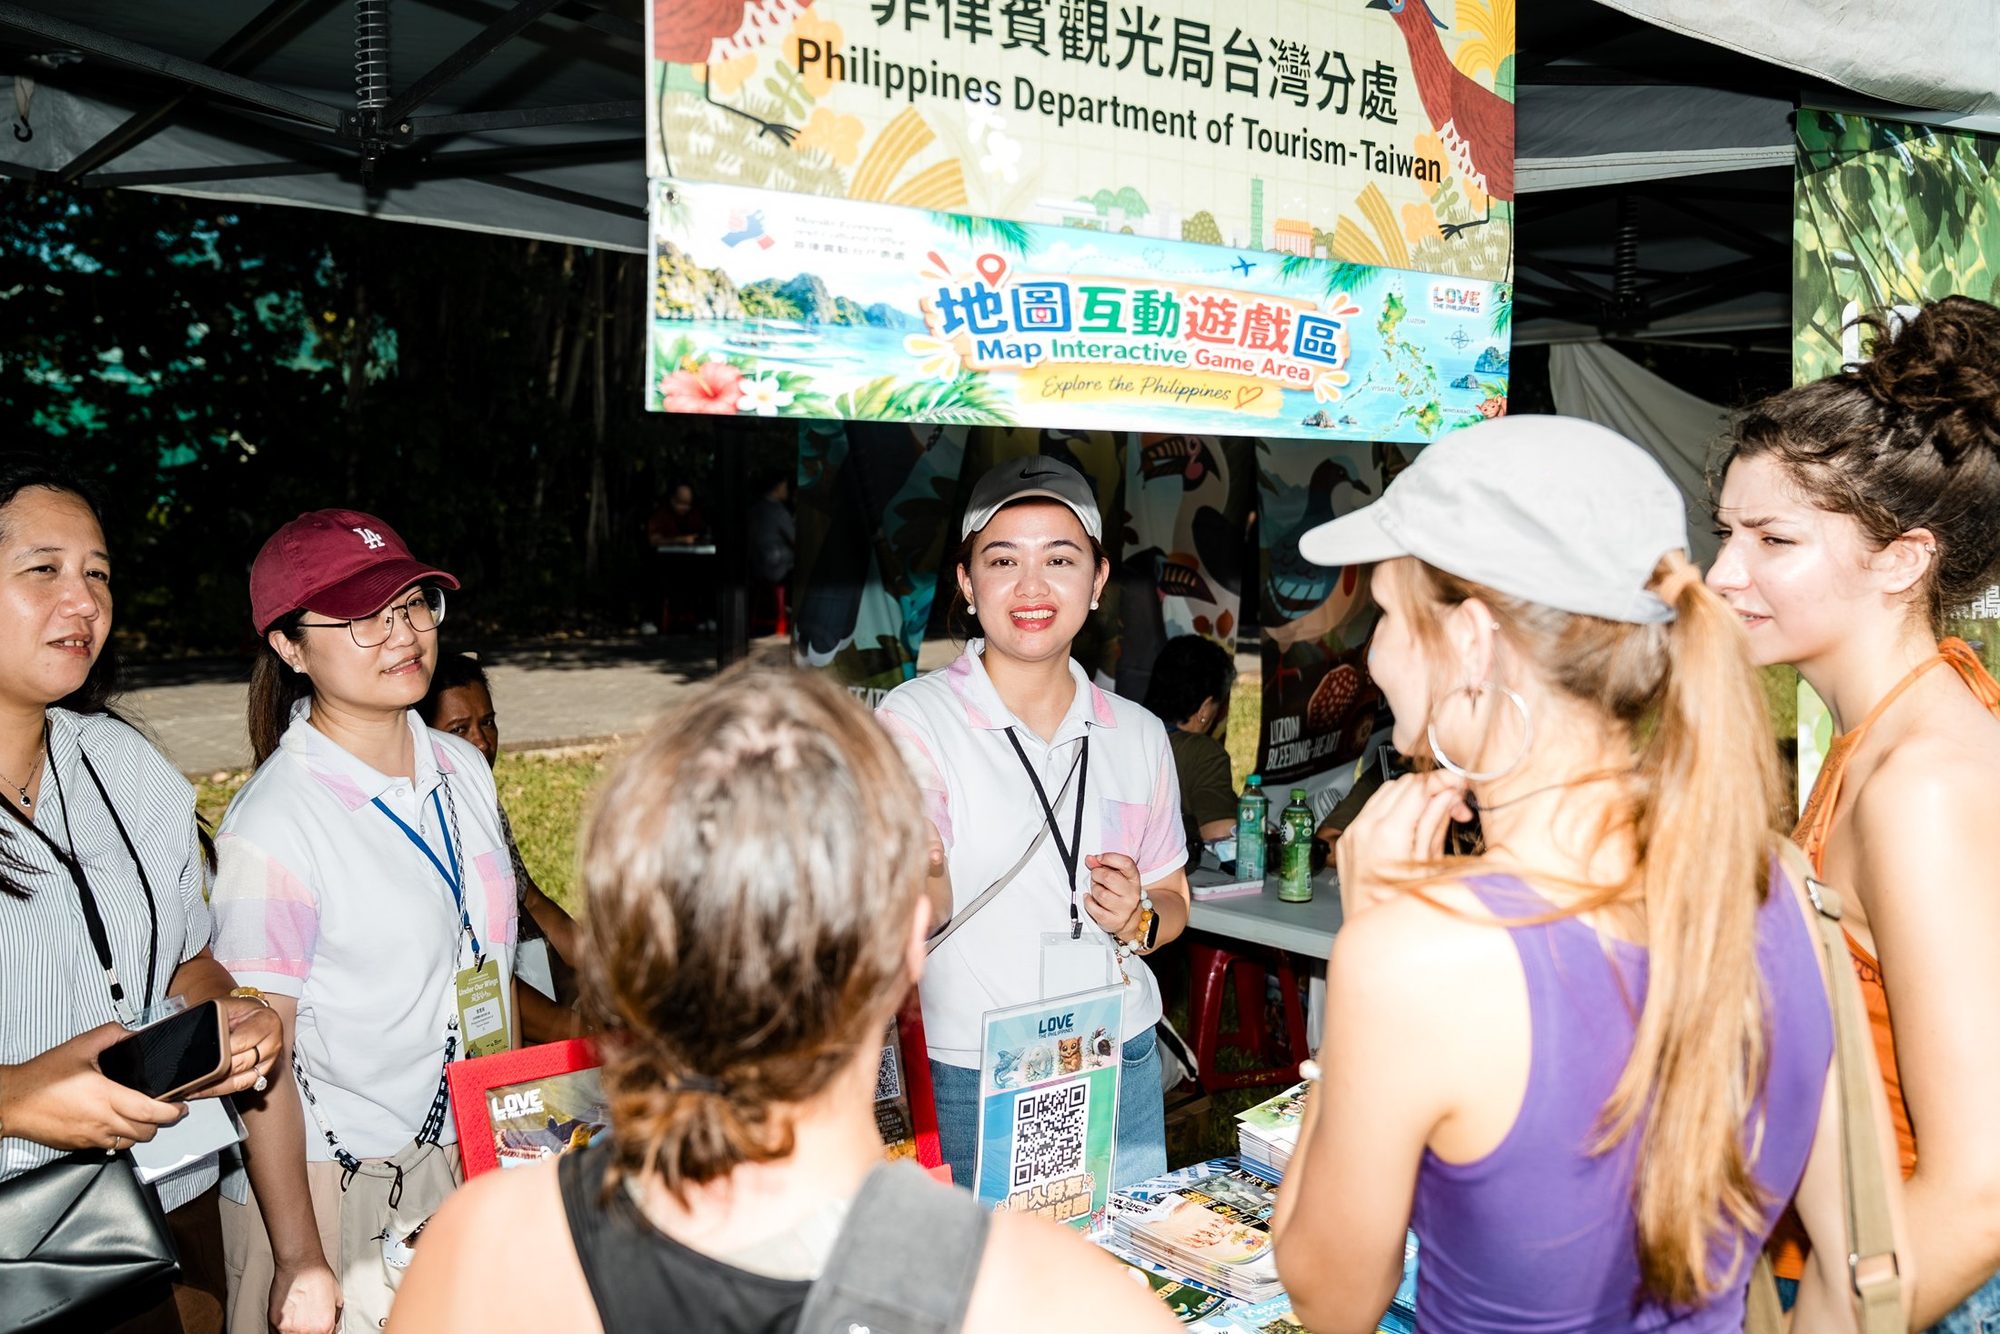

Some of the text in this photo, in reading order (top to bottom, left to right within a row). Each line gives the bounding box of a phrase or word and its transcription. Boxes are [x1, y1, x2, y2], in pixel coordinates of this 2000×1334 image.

[797, 38, 1442, 184] Philippines Department of Tourism-Taiwan
[1433, 287, 1480, 306] LOVE
[935, 281, 1341, 366] 地圖互動遊戲區
[976, 339, 1311, 382] Map Interactive Game Area
[1041, 374, 1232, 402] Explore the Philippines
[352, 527, 386, 550] LA
[1269, 715, 1301, 746] LUZON
[1038, 1012, 1076, 1034] LOVE
[491, 1087, 544, 1115] LOVE
